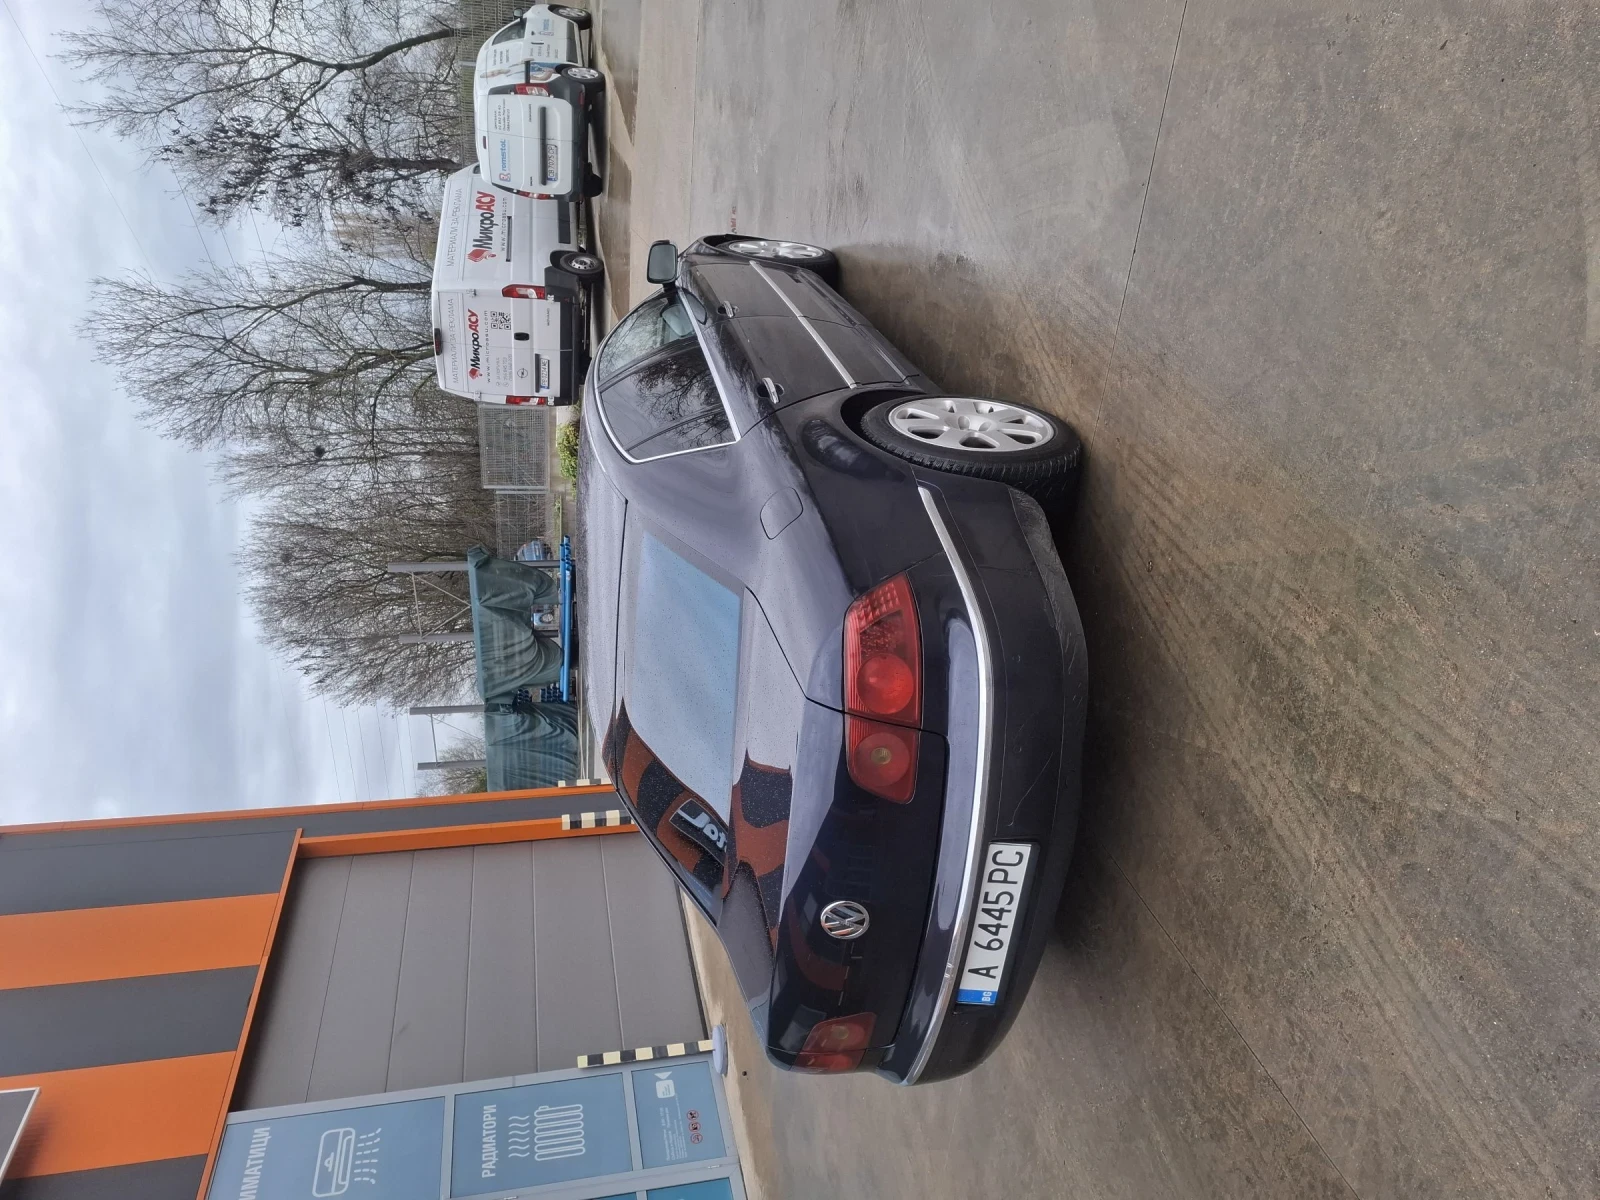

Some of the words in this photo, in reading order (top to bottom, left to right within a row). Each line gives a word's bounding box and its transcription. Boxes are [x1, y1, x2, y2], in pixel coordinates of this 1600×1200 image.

[451, 188, 462, 217] РЕКЛАМА
[451, 217, 459, 226] ЗА
[472, 191, 499, 250] МикроАСУ
[446, 226, 459, 267] МАТЕРИАЛИ
[447, 298, 456, 331] РЕКЛАМА
[449, 333, 457, 343] ЗА
[467, 308, 482, 370] МикроАСУ
[483, 310, 491, 383] www.microasu.com
[450, 343, 459, 384] МАТЕРИАЛИ
[987, 850, 1024, 885] PC
[974, 891, 1014, 951] 6445
[967, 965, 999, 980] A
[981, 991, 993, 1002] BG
[481, 1104, 498, 1178] РАДИАТОРИ
[238, 1127, 272, 1200] ИМАТИЦИ
